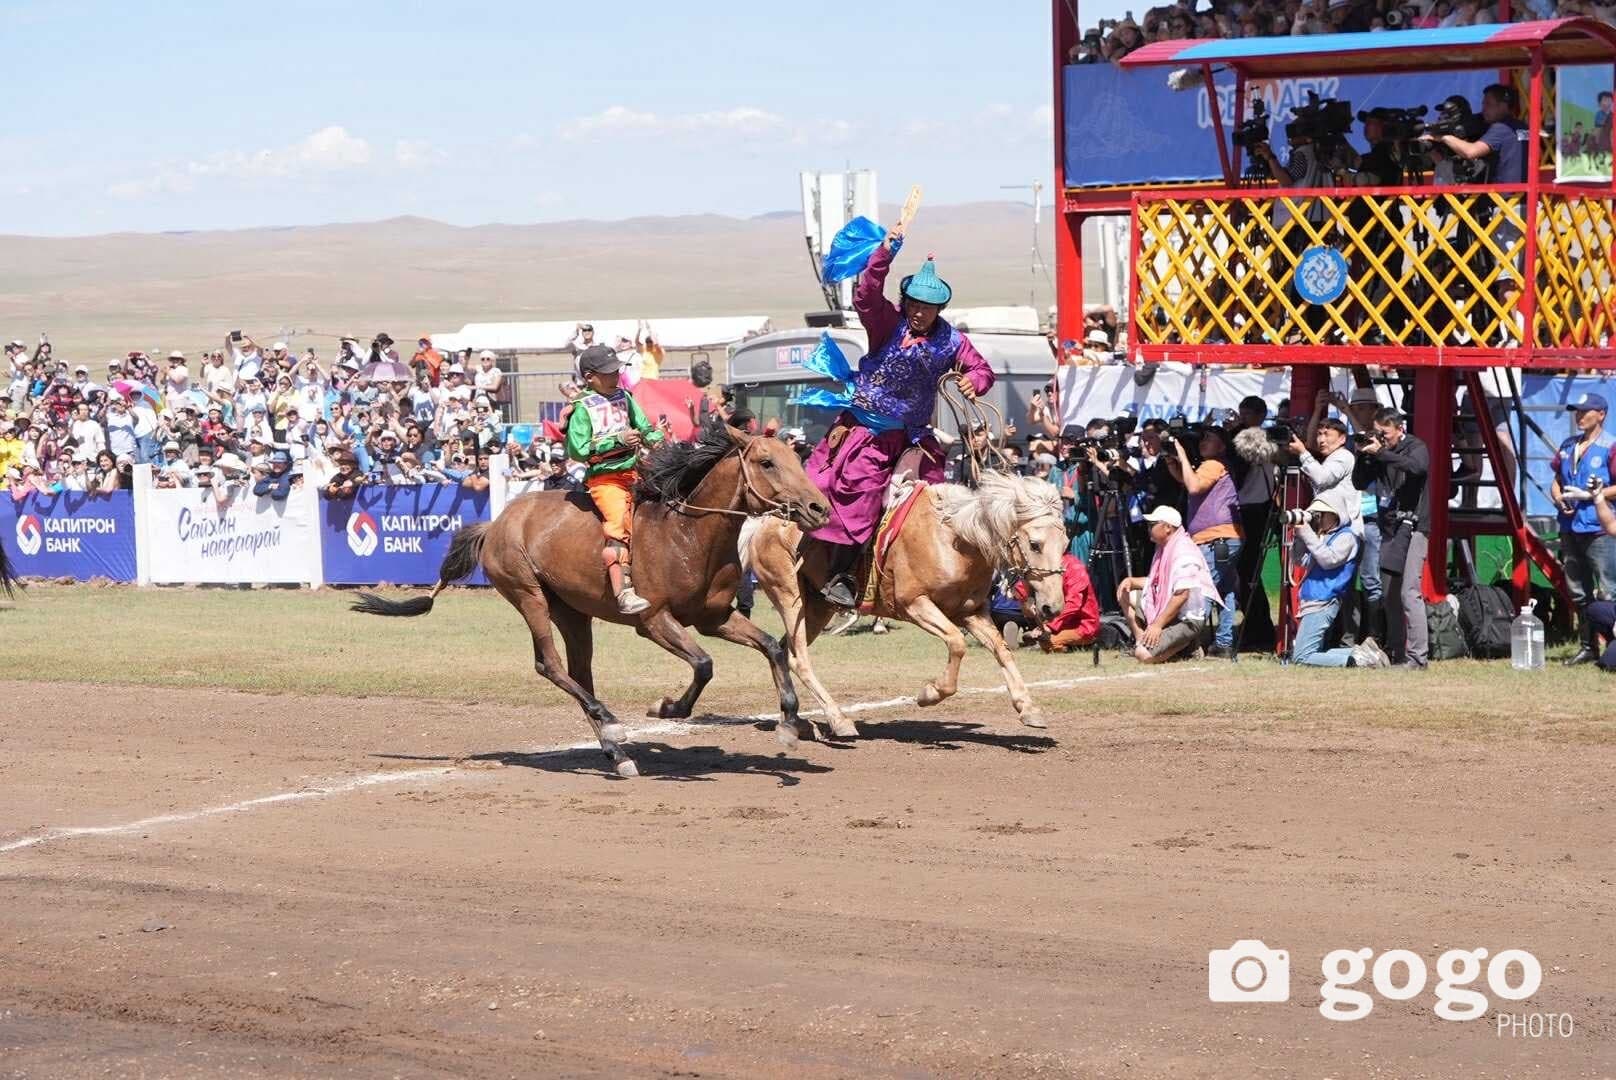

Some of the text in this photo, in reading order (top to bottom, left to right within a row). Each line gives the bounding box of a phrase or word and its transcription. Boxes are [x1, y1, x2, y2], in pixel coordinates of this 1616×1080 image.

[43, 518, 116, 534] КАПИТРОН
[178, 507, 236, 542] Сайхан
[381, 514, 462, 532] КАПИТРОН
[46, 537, 81, 553] БАНК
[201, 525, 281, 562] наадаарай
[383, 536, 423, 553] БАНК
